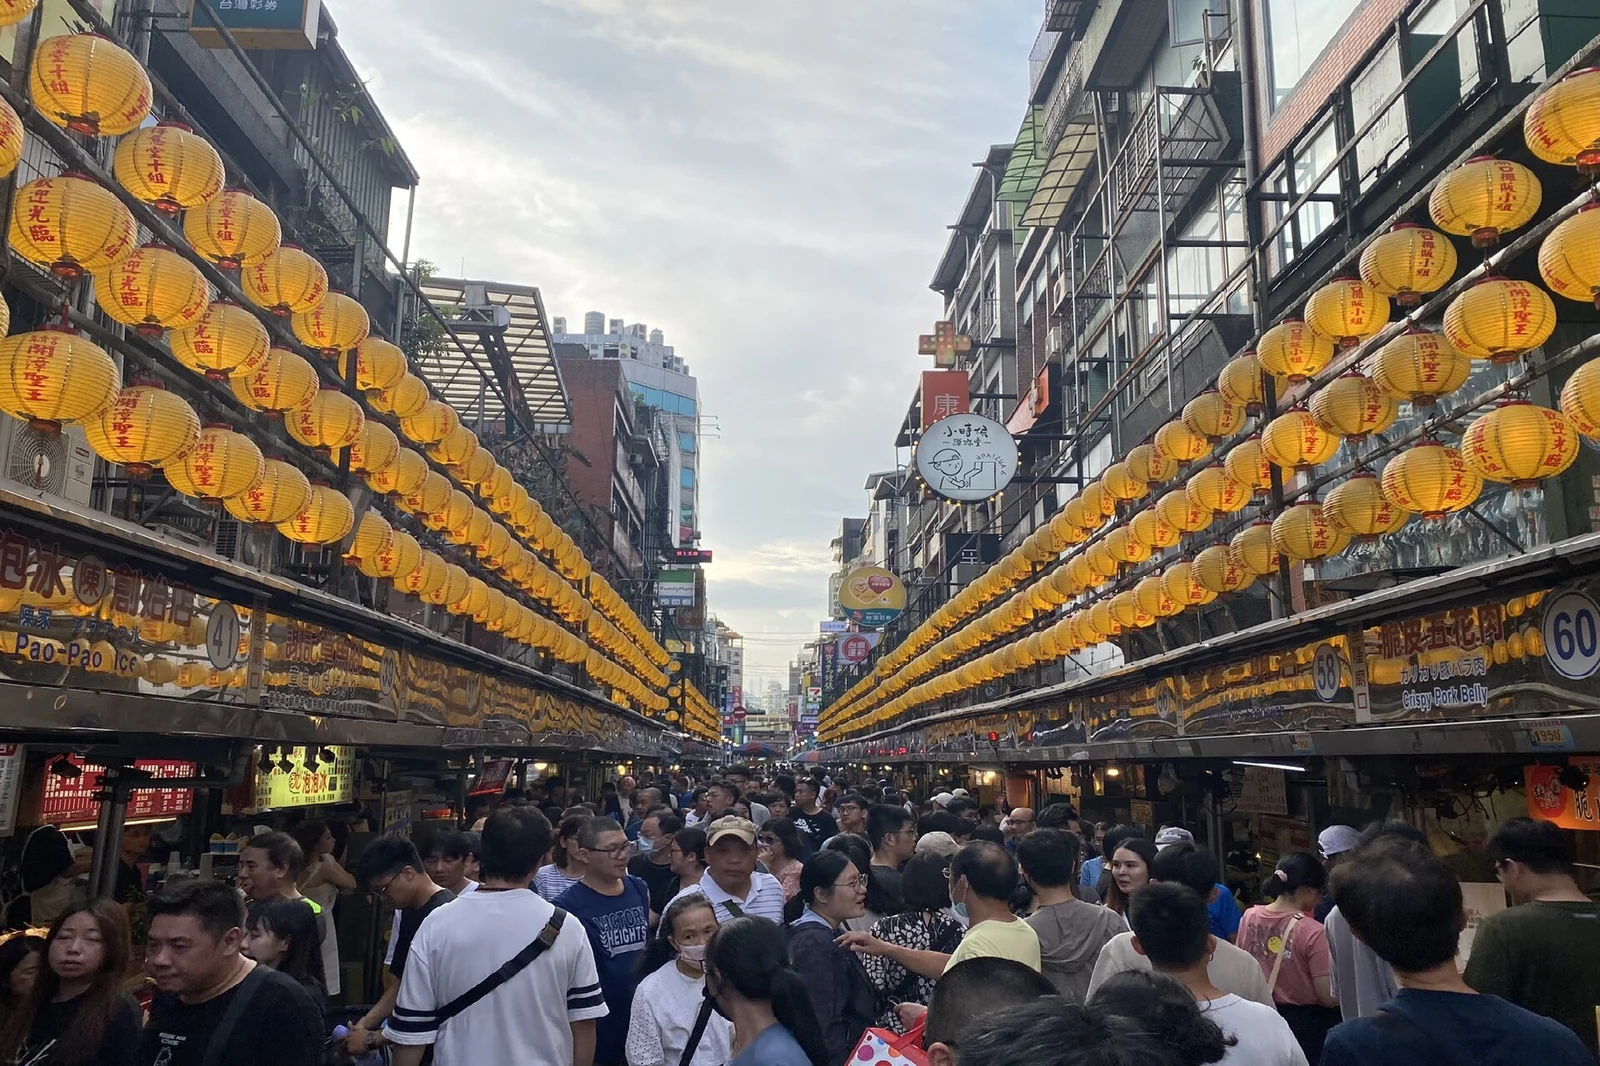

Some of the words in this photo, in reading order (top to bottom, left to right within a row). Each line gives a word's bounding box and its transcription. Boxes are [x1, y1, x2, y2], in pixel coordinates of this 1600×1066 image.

[24, 345, 55, 402] 開漳聖王
[252, 356, 271, 398] 迎光臨
[933, 394, 960, 416] 康
[943, 423, 989, 438] 小時候
[660, 585, 693, 593] FamilyMart
[212, 613, 234, 659] 41
[1553, 608, 1598, 661] 60
[16, 632, 103, 673] Pao-Pao
[382, 658, 394, 683] 39
[1317, 653, 1336, 691] 58
[1402, 689, 1432, 712] Crispy
[1435, 687, 1458, 706] Pork
[1461, 683, 1487, 707] Belly
[606, 926, 647, 946] HEIGHTS
